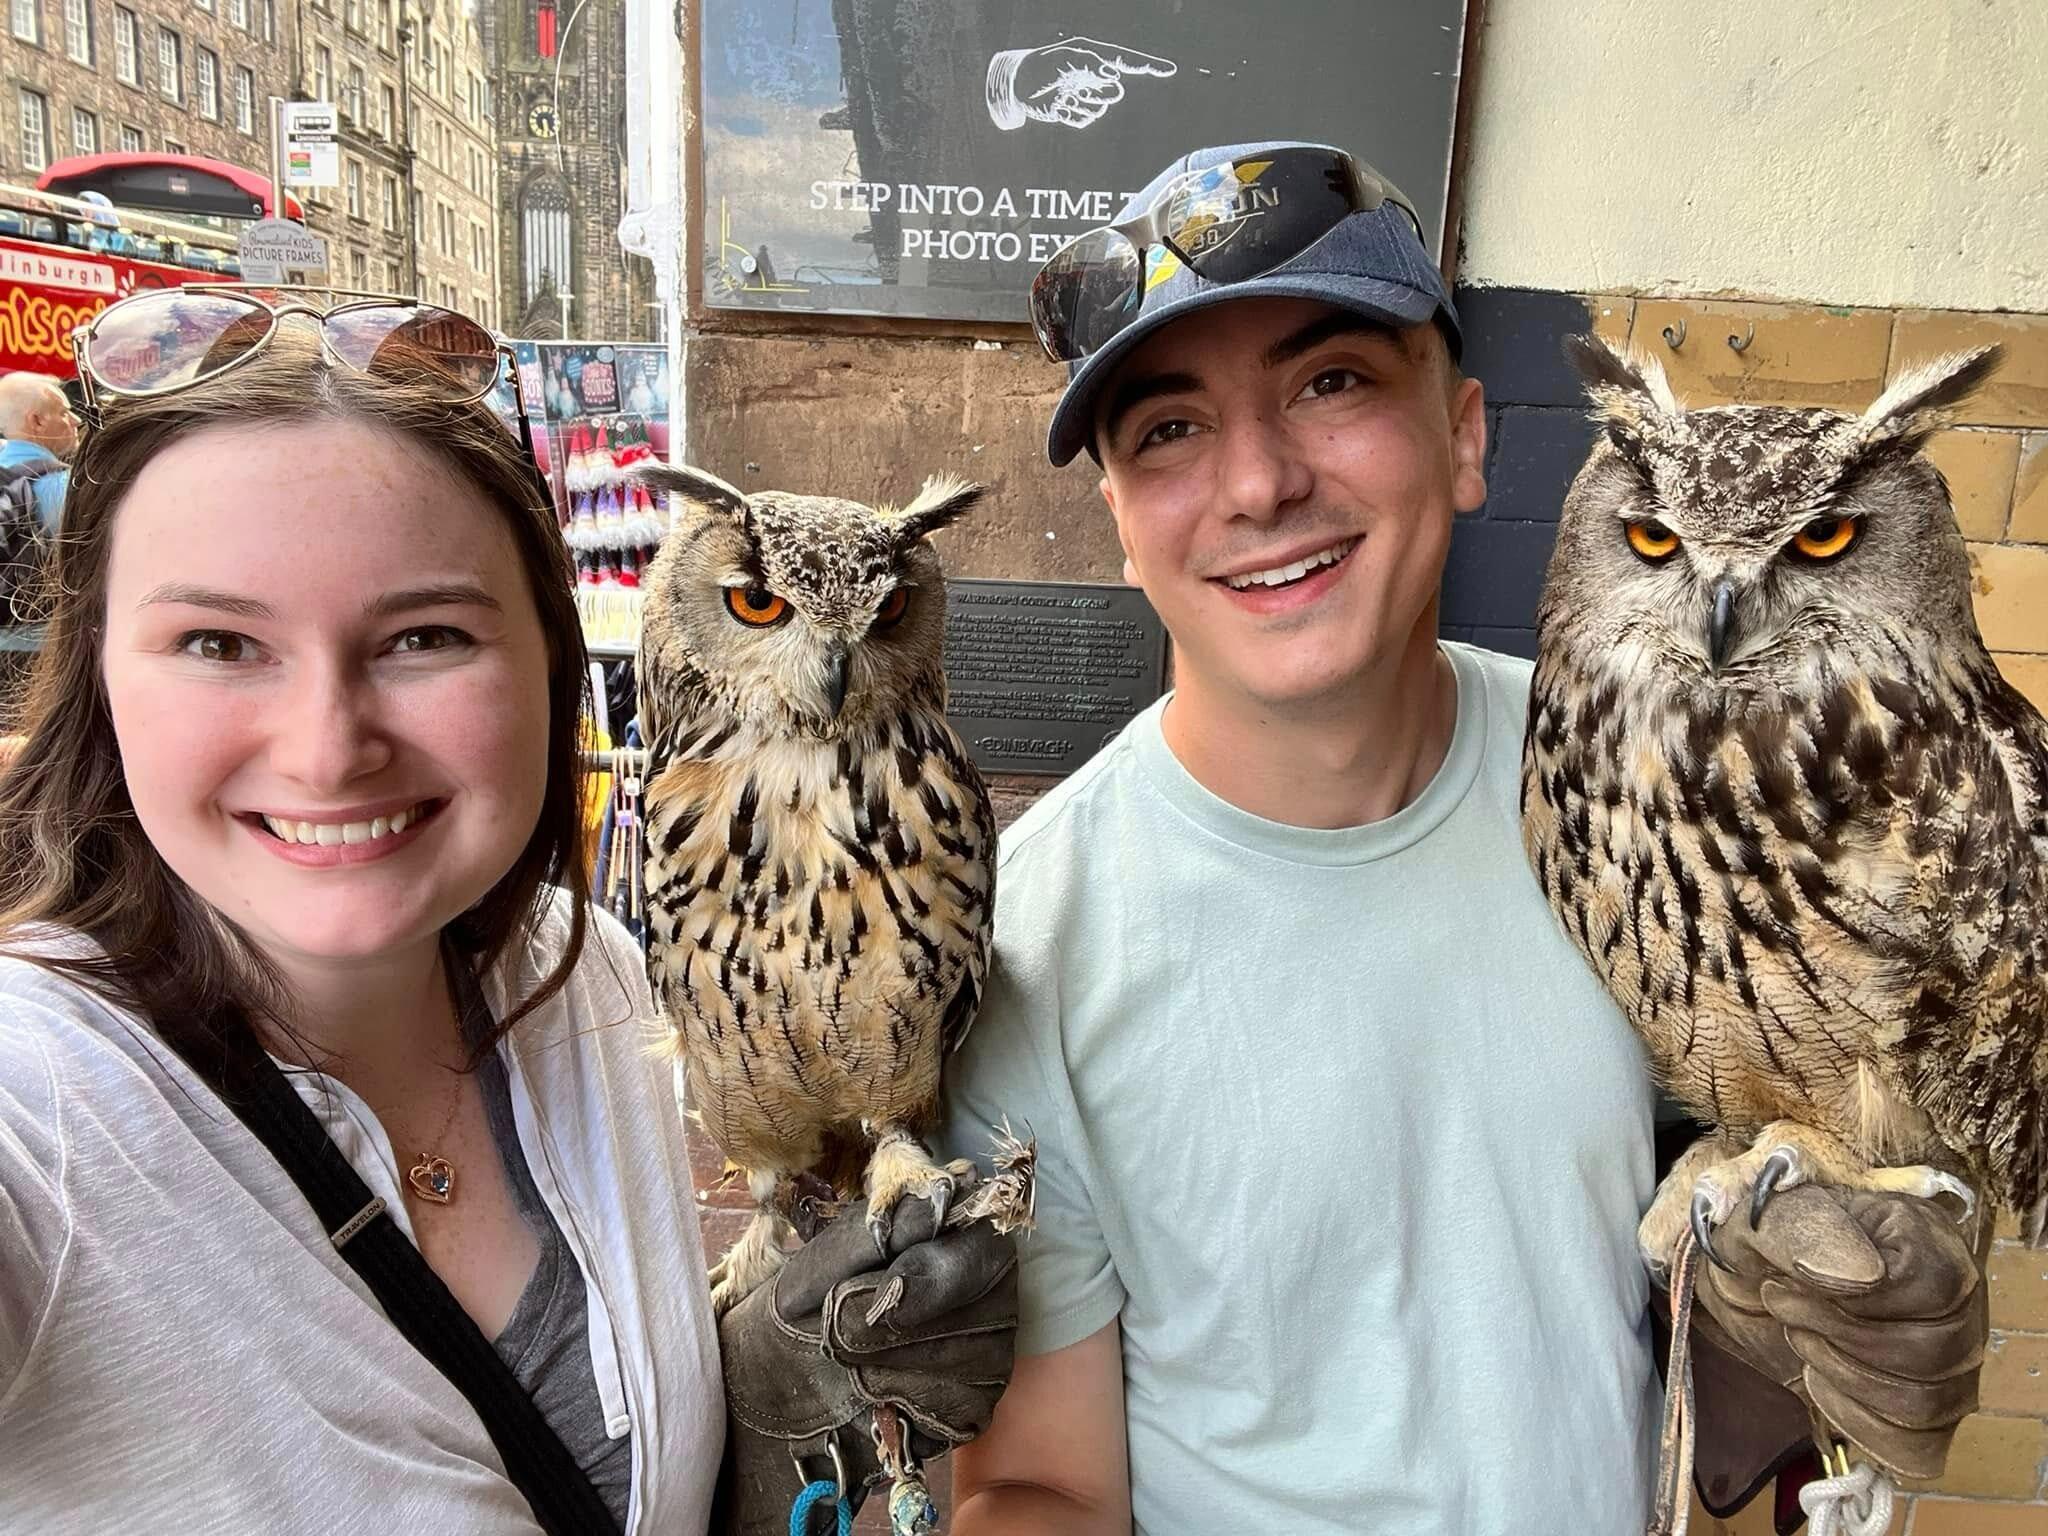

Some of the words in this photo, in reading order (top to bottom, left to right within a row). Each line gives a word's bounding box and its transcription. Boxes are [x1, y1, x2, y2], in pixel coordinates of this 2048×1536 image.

[810, 181, 892, 213] STEP
[897, 184, 984, 216] INTO
[990, 188, 1018, 218] A
[1025, 189, 1112, 221] TIME
[243, 246, 284, 261] PICTURE
[286, 250, 323, 264] FRAMES
[293, 239, 313, 249] KIDS
[902, 228, 1022, 261] PHOTO
[340, 1203, 380, 1240] TRAVELON
